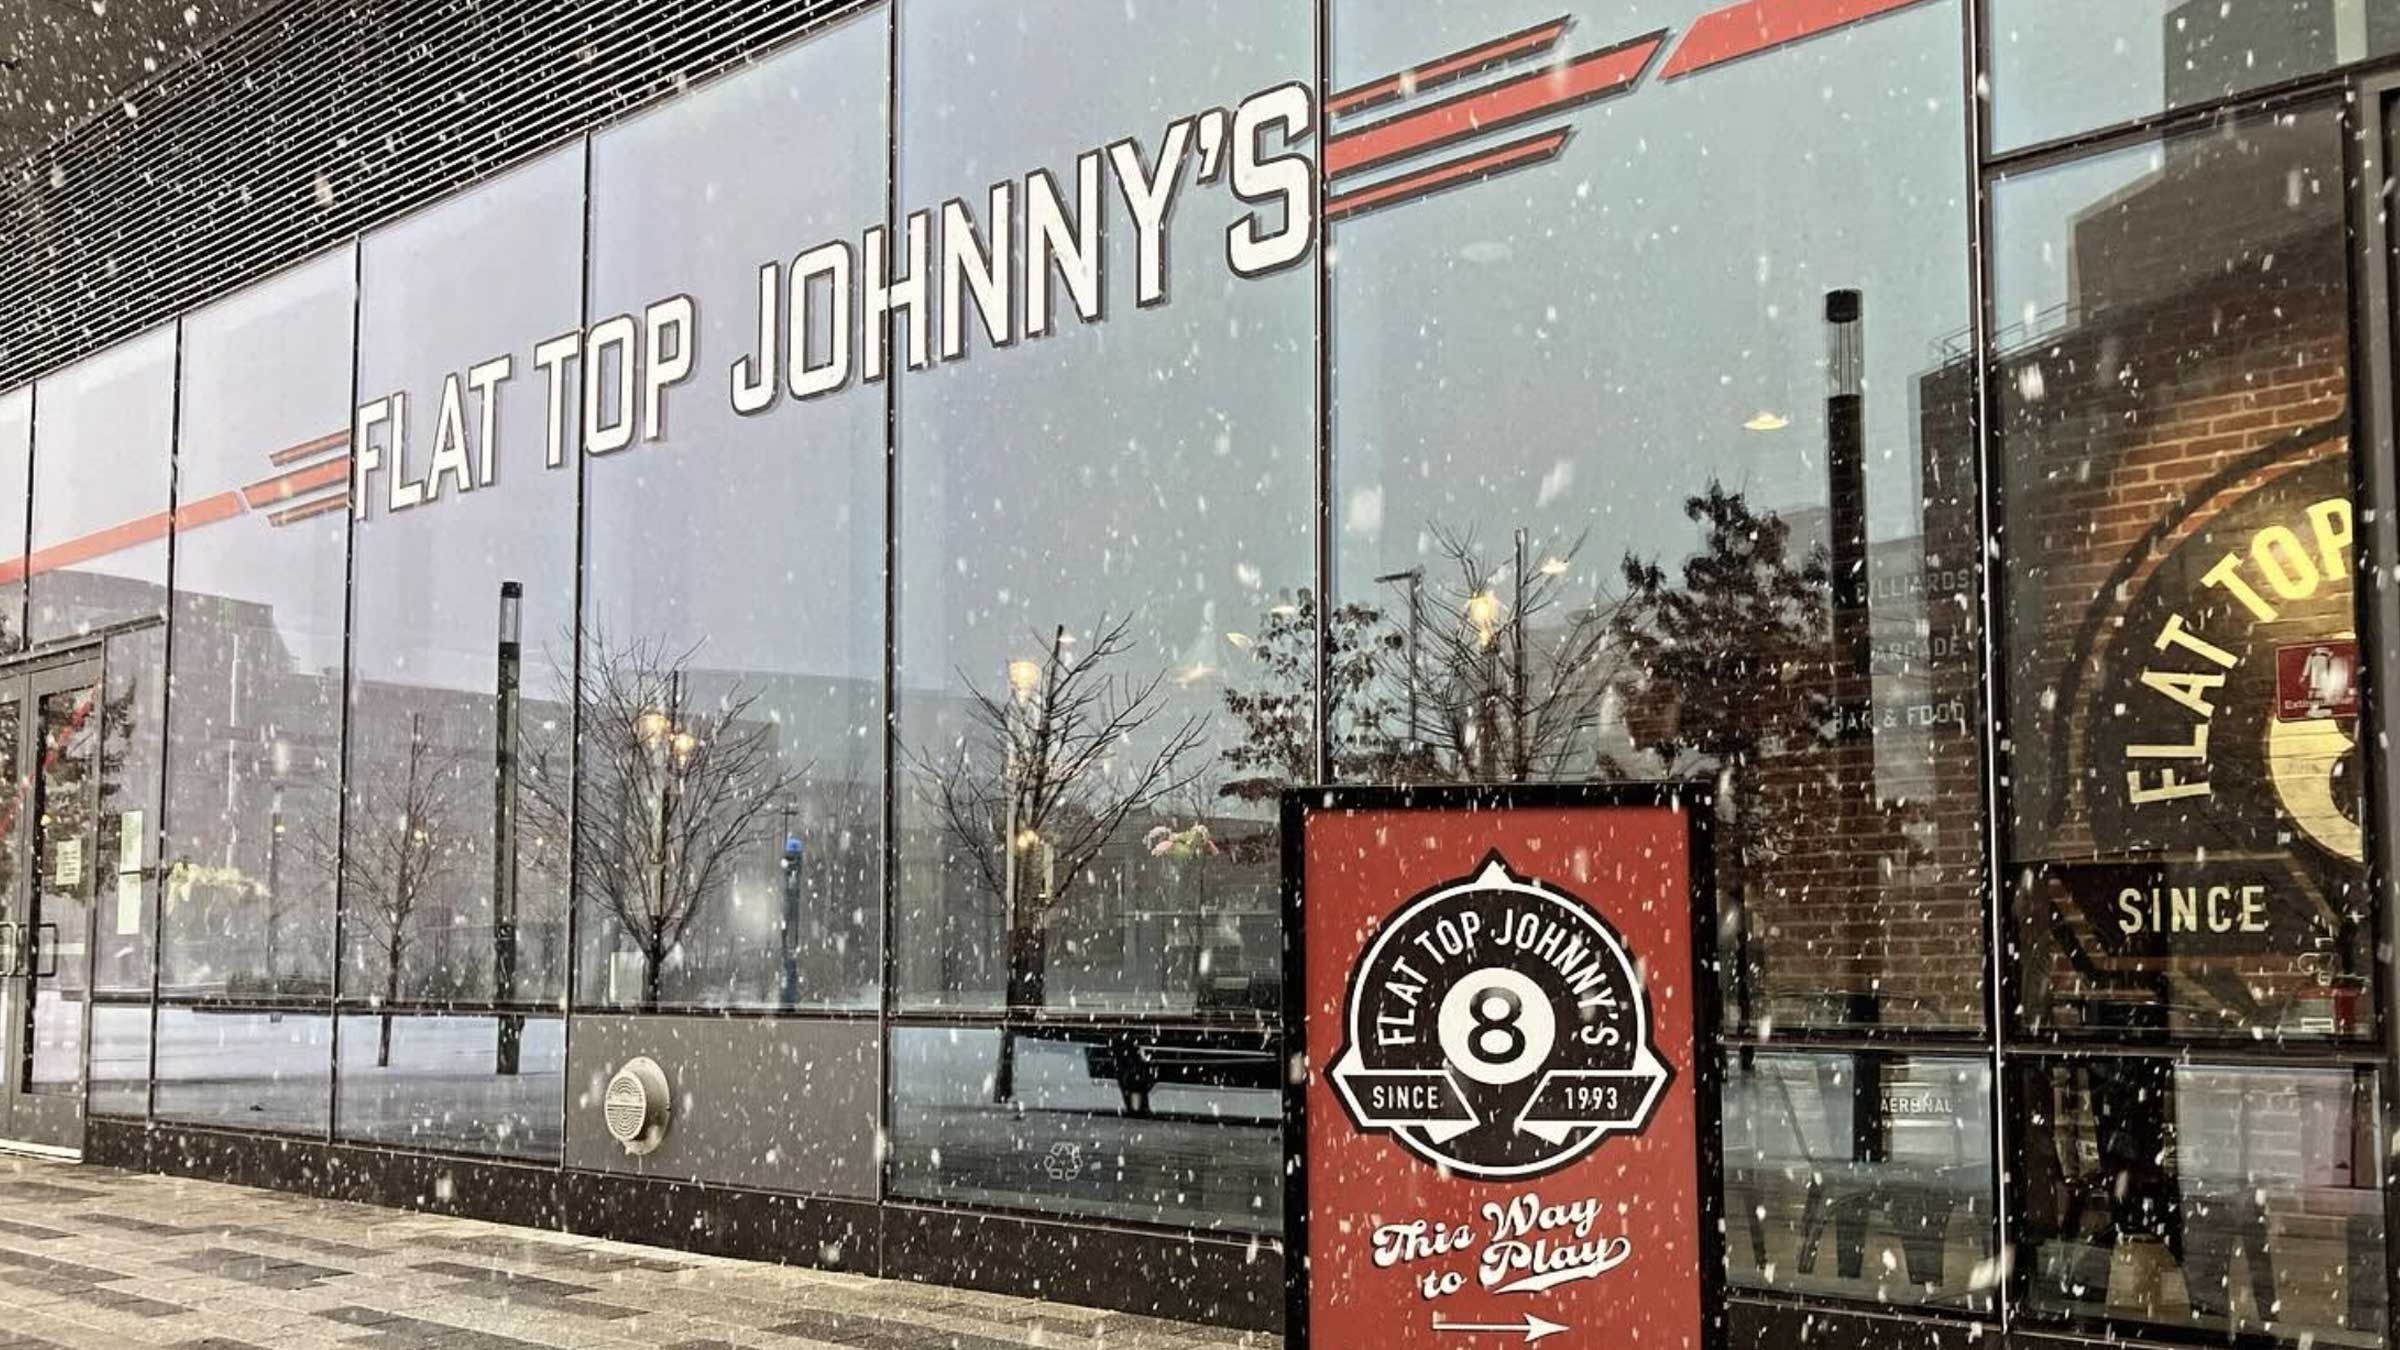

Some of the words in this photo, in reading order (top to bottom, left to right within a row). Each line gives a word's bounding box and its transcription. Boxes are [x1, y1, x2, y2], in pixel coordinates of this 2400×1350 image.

[354, 353, 513, 522] FLAT
[533, 293, 698, 470] TOP
[730, 80, 1316, 416] JOHNNY'S
[2126, 613, 2238, 804] FLAT
[2201, 497, 2353, 623] TOP
[2118, 885, 2267, 934] SINCE
[1377, 955, 1428, 1046] FLAT
[1414, 911, 1480, 965] TOP
[1494, 908, 1620, 1047] JOHNNY'S
[1467, 987, 1527, 1064] 8
[1372, 1085, 1439, 1110] SINCE
[1564, 1086, 1618, 1110] 1993
[1371, 1218, 1476, 1268] This
[1480, 1192, 1603, 1238] Way
[1420, 1269, 1468, 1300] to
[1478, 1236, 1632, 1295] Play
